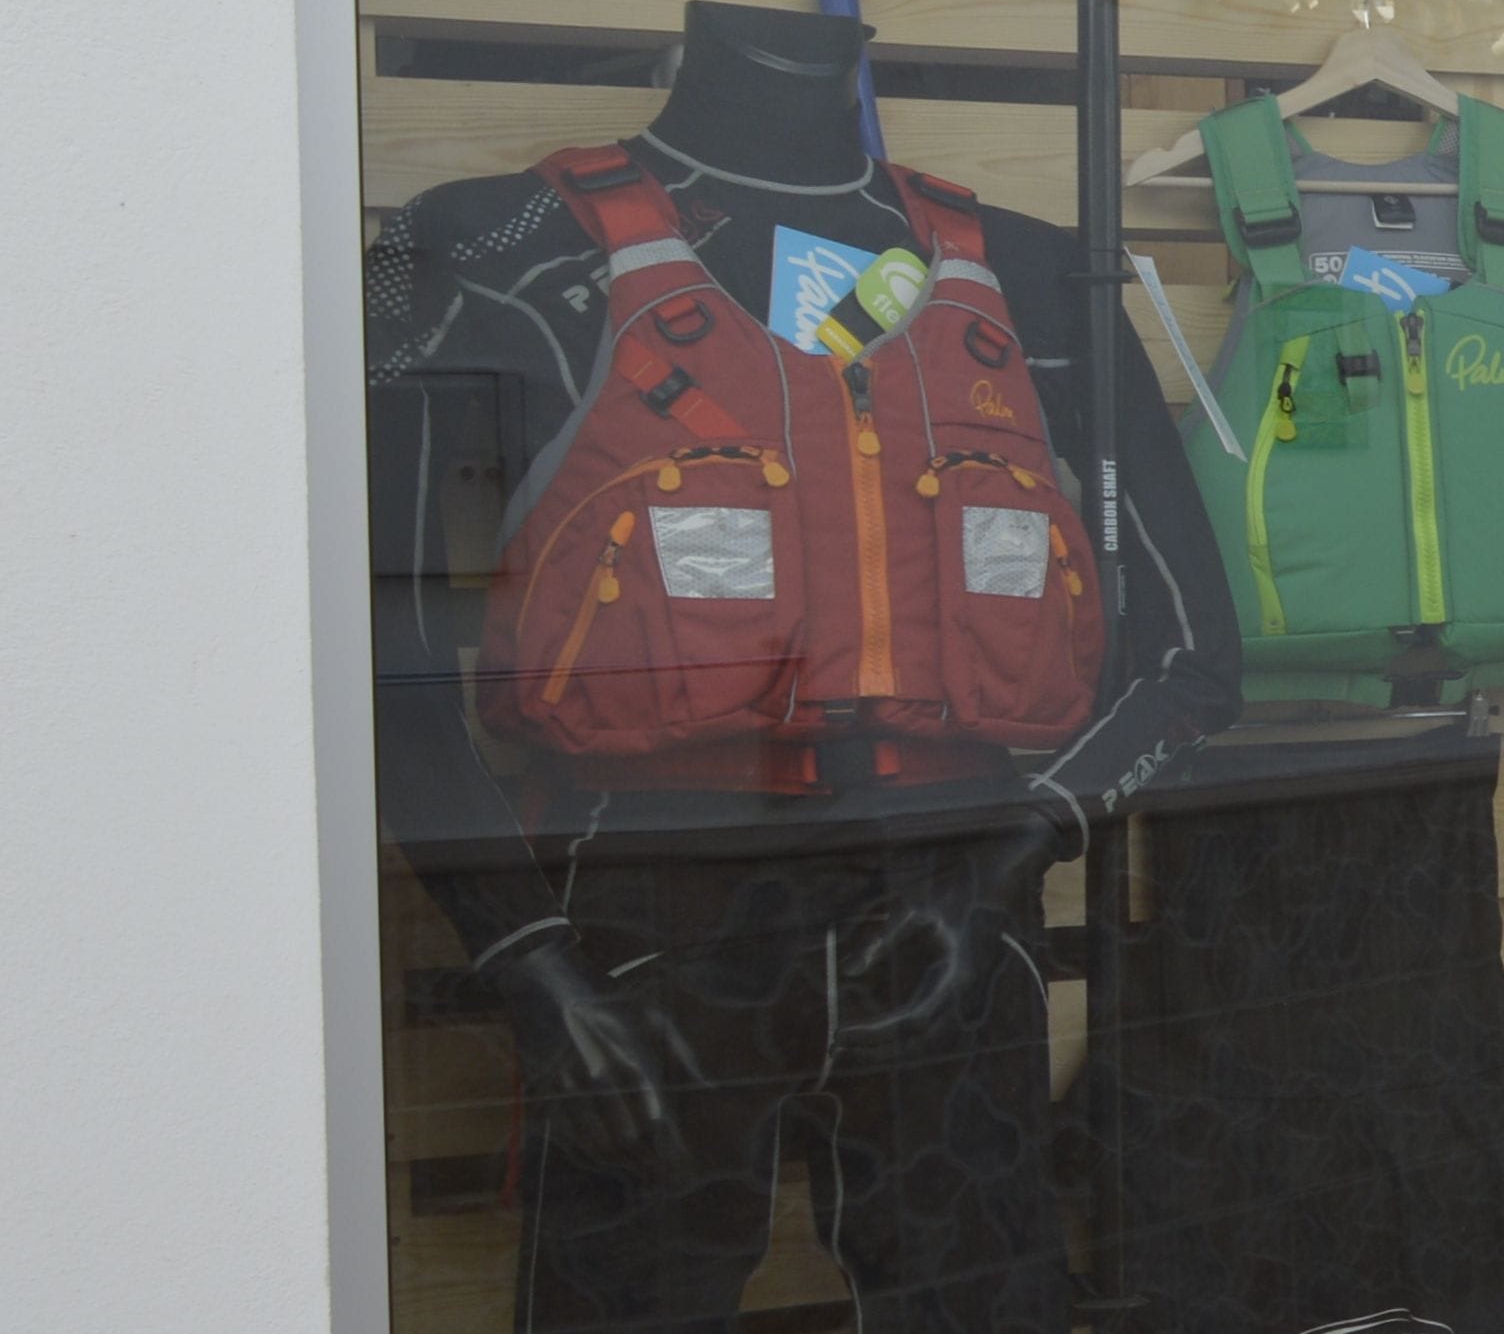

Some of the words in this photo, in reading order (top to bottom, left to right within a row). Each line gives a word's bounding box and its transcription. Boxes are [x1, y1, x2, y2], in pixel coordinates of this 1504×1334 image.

[1315, 257, 1342, 273] 50
[1102, 460, 1117, 498] SHAFT
[1104, 501, 1118, 551] CARBON
